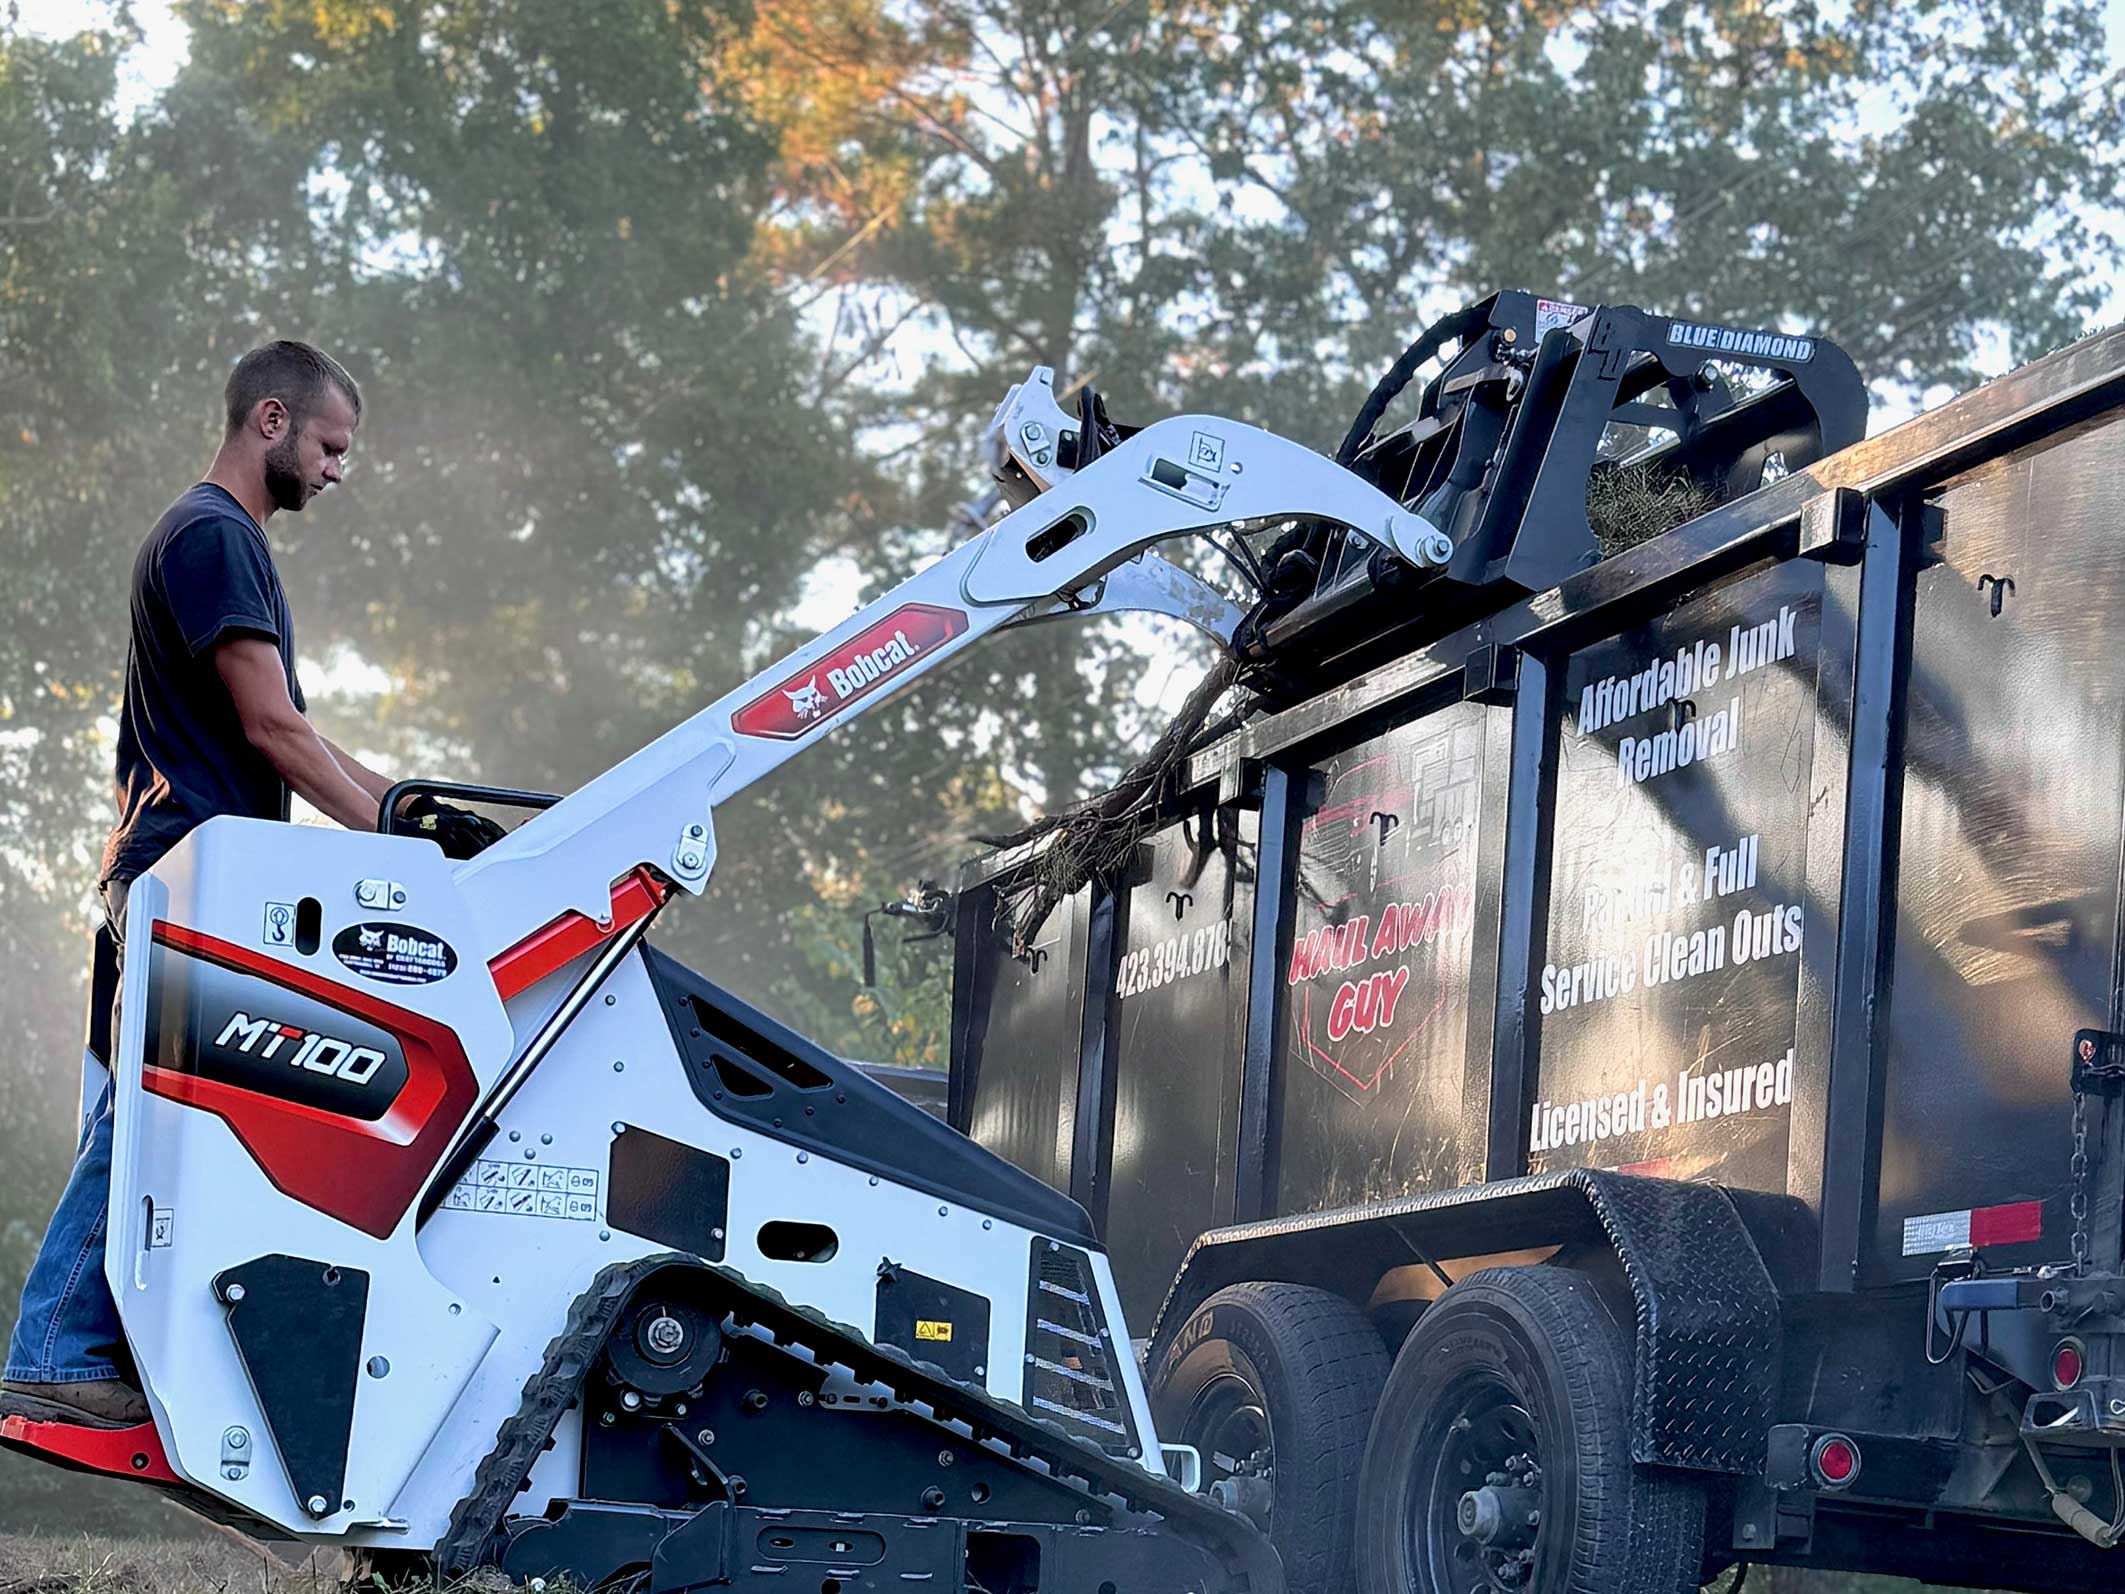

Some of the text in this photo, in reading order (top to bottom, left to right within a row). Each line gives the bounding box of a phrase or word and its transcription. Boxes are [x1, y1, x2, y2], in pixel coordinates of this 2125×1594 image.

[1669, 324, 1811, 360] BLUE DIAMOND
[1576, 605, 1798, 737] Affordable Junk
[1616, 696, 1740, 789] Removal
[1679, 862, 1698, 910] &
[1704, 833, 1760, 901] Full
[1288, 915, 1370, 986] HAUL
[1539, 903, 1803, 1015] Service Clean Outs
[1327, 964, 1410, 1042] GUY
[214, 1012, 387, 1086] MT100
[1529, 1048, 1795, 1153] Licensed & Insured
